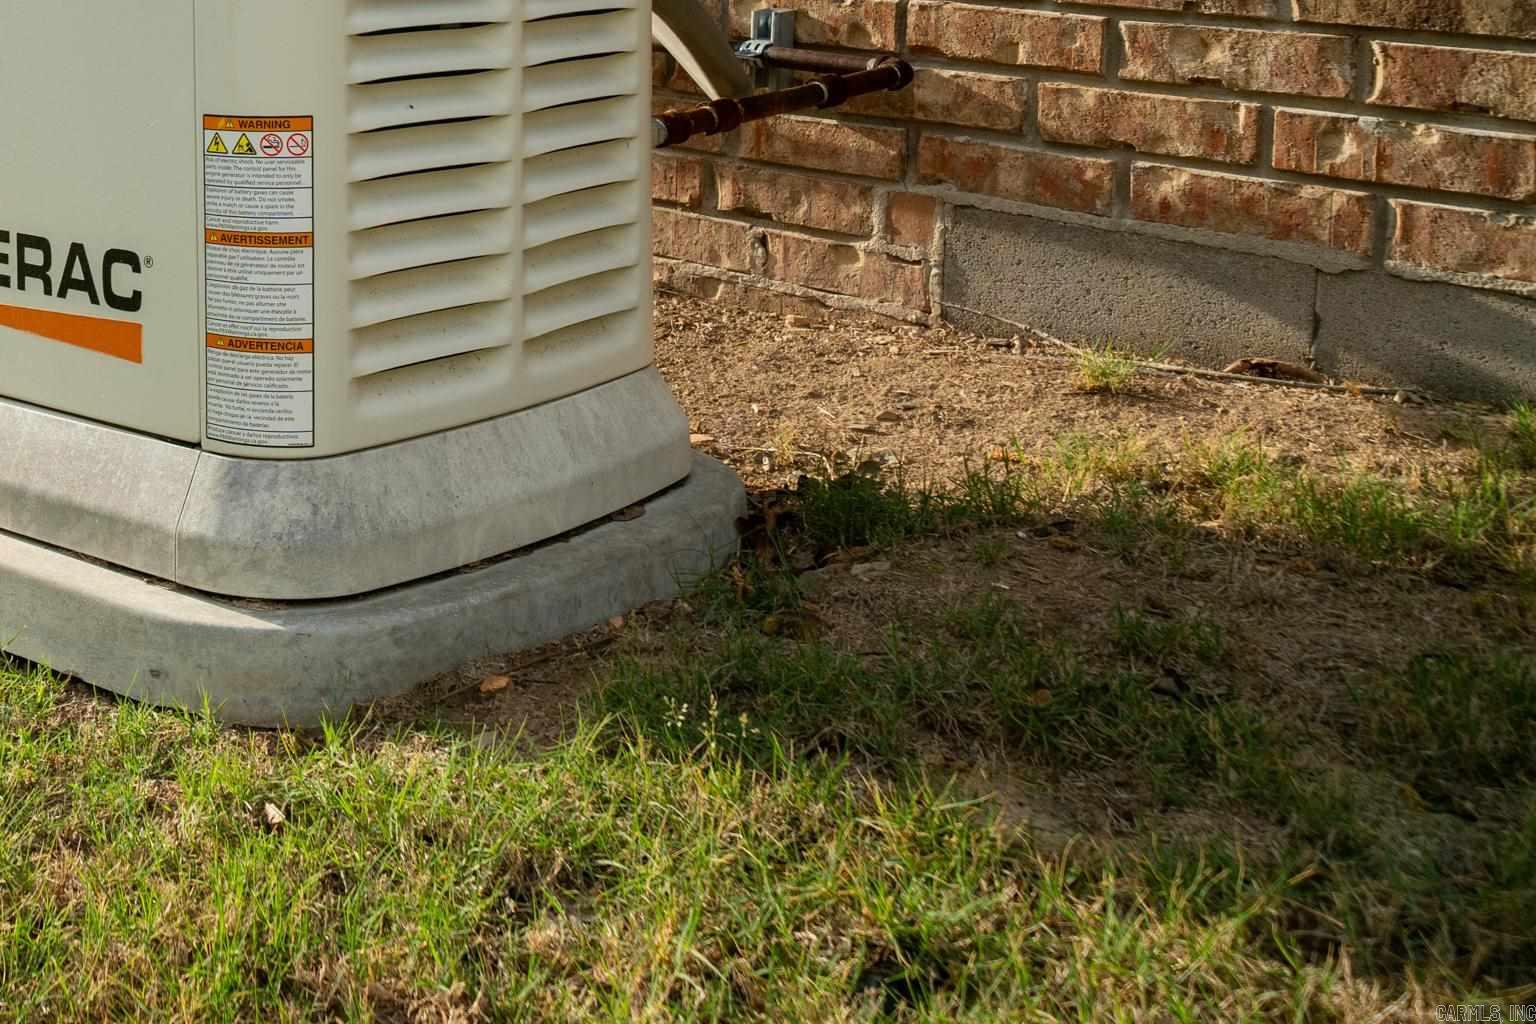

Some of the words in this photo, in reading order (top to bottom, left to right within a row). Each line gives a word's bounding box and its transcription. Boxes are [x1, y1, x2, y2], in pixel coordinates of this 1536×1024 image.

[238, 119, 291, 129] WARNING
[220, 233, 308, 245] AVERTISSEMENT
[228, 339, 303, 351] ADVERTENCIA
